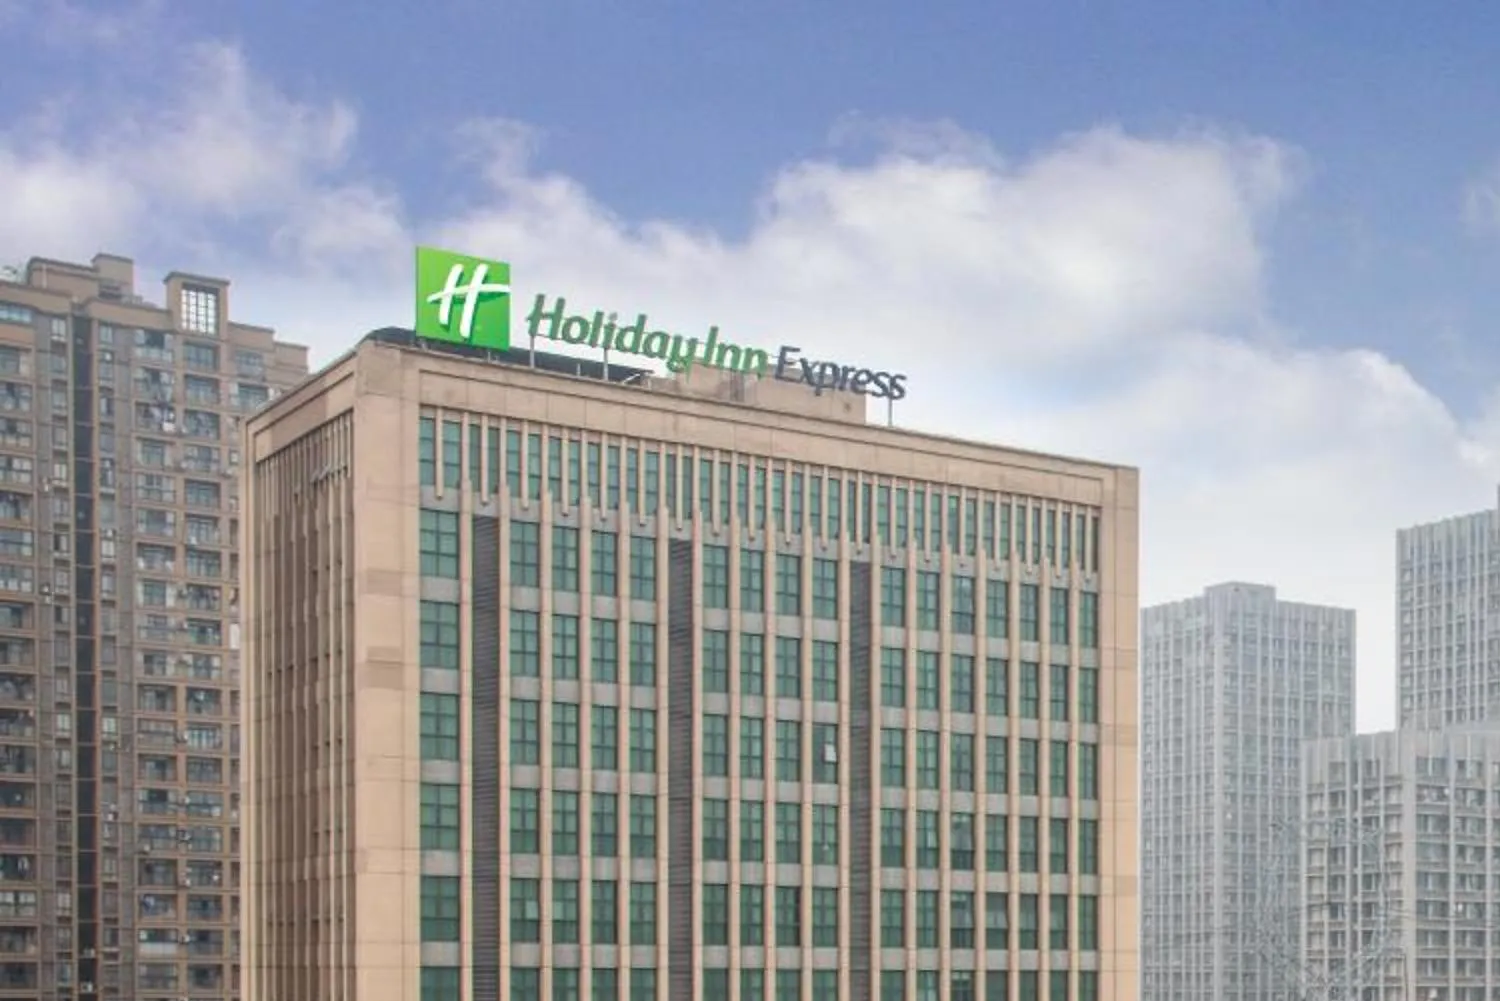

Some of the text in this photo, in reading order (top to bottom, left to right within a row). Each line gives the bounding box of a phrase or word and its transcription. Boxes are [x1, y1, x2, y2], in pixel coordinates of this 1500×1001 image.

[526, 294, 906, 400] Holiday Inn Express
